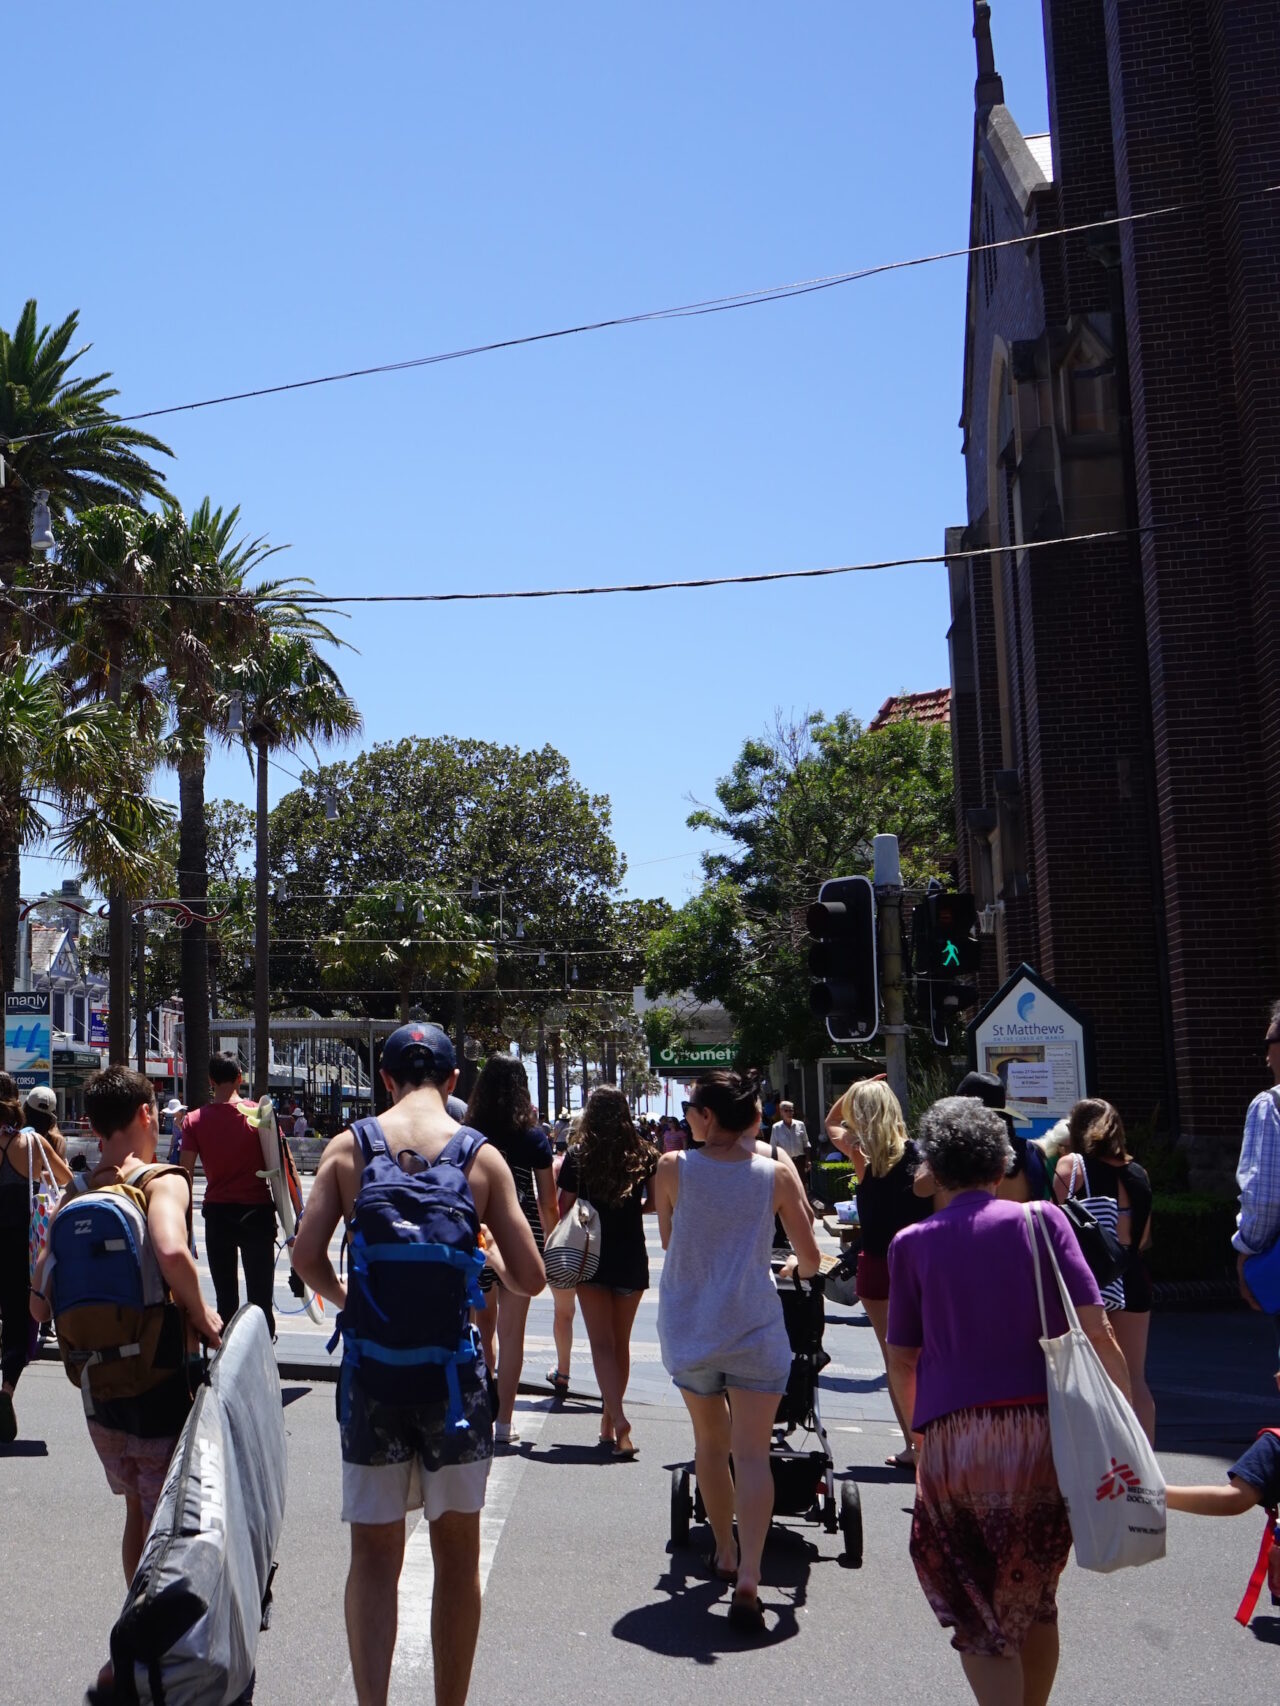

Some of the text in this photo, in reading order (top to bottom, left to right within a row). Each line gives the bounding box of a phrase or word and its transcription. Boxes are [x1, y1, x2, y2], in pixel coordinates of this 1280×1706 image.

[7, 995, 47, 1010] manly
[992, 1023, 1065, 1036] St Matthews
[16, 1076, 36, 1085] CORSO
